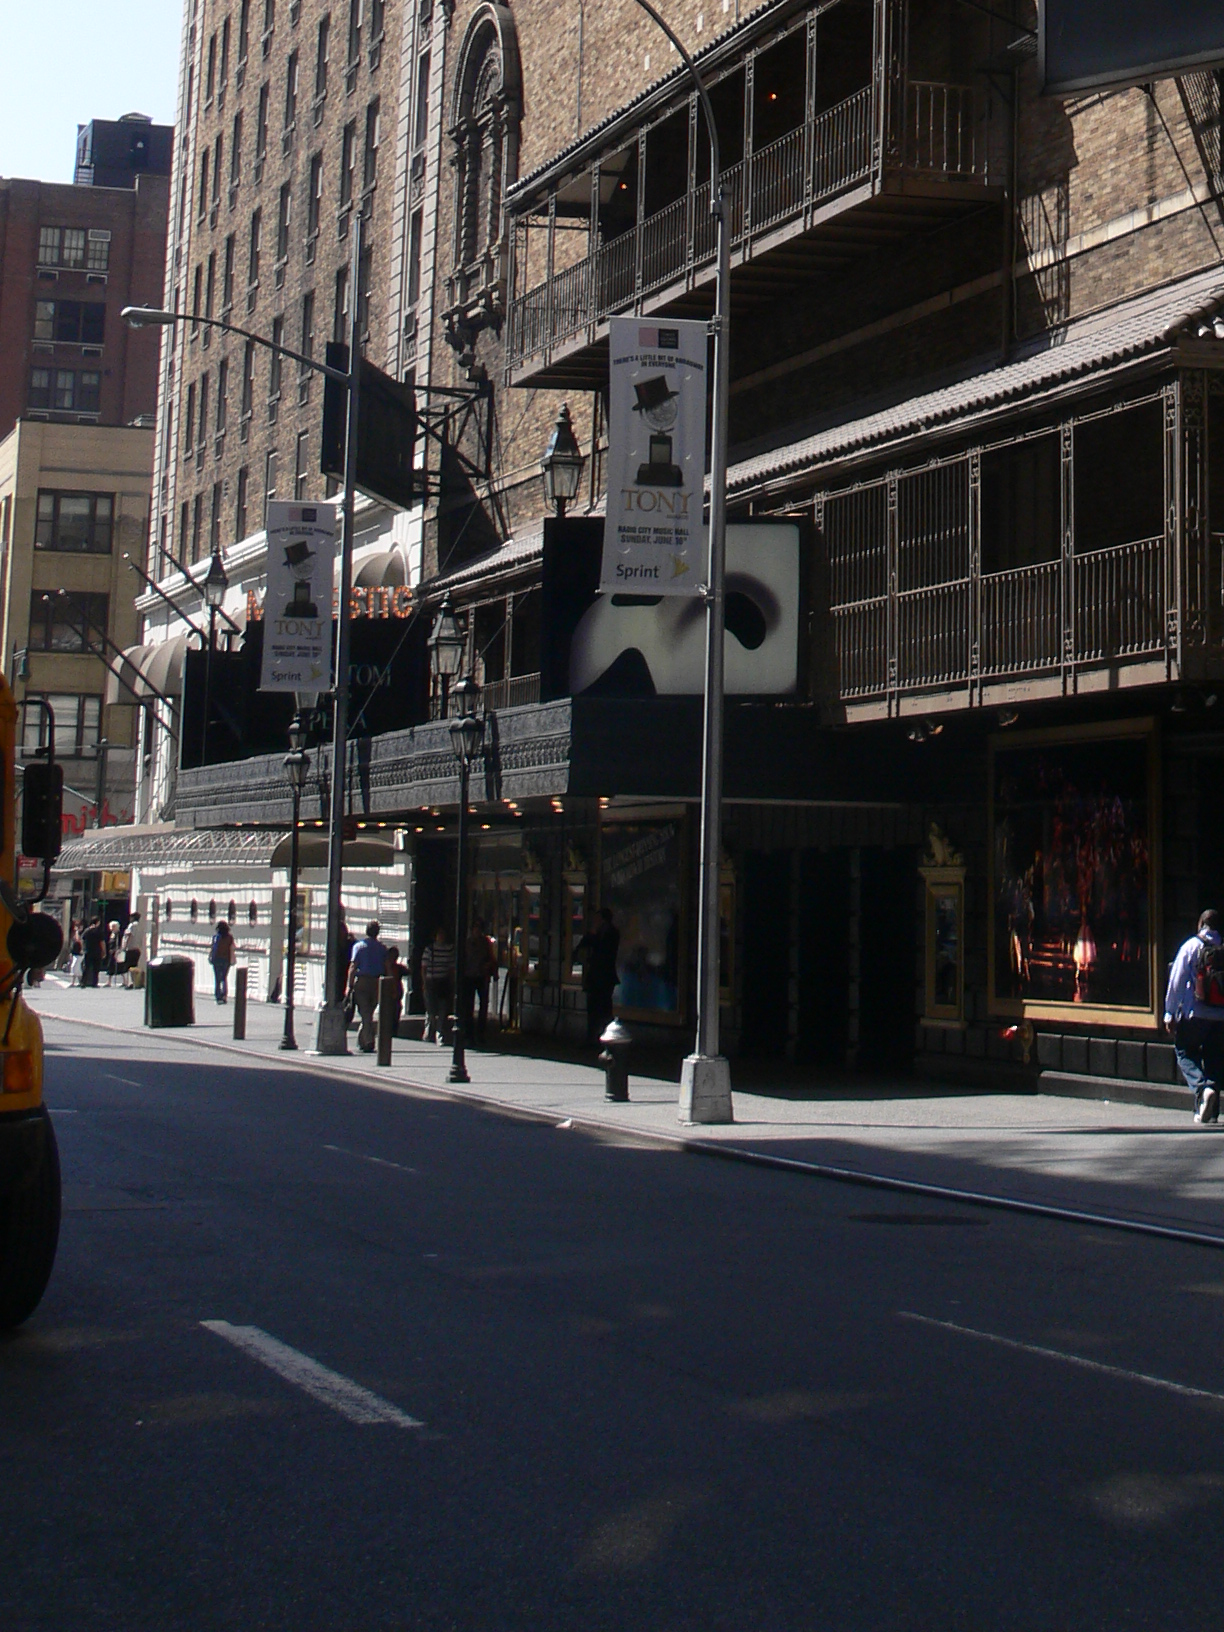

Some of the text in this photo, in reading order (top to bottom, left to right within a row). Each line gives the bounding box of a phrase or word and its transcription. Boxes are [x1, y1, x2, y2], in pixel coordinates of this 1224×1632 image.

[621, 488, 694, 514] TONY
[638, 526, 652, 534] CITY
[616, 564, 660, 580] Sprint
[273, 620, 326, 636] TONY
[271, 670, 302, 682] Sprint
